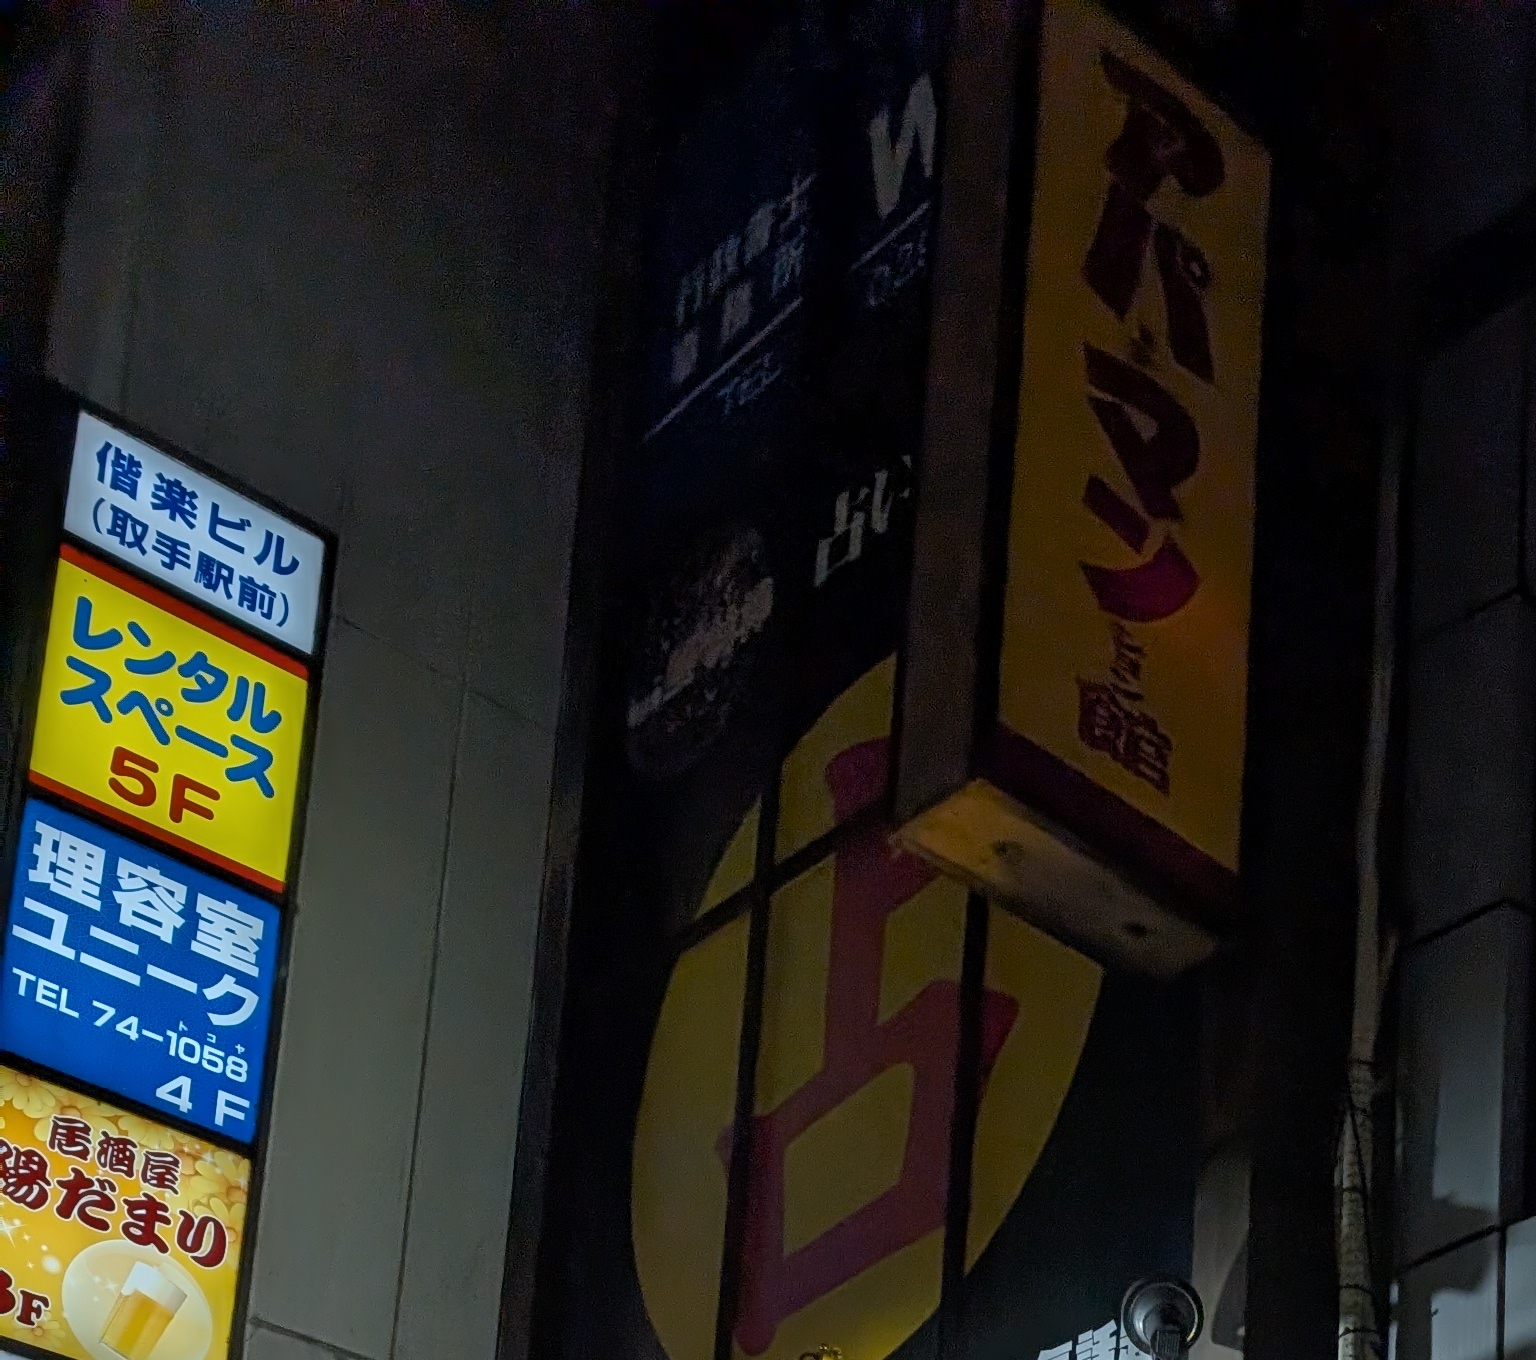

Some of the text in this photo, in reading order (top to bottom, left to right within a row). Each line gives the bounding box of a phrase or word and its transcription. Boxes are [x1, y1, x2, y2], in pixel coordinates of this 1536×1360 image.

[92, 498, 290, 628] (取手駅前)
[96, 441, 300, 576] 偕楽ビル
[60, 655, 276, 799] スペース
[72, 596, 282, 734] レンタル
[108, 746, 221, 823] 5F
[12, 896, 259, 1026] ユニーク
[28, 821, 264, 978] 理容室
[13, 967, 249, 1083] TEL 74-1058
[48, 1114, 181, 1195] 居酒屋
